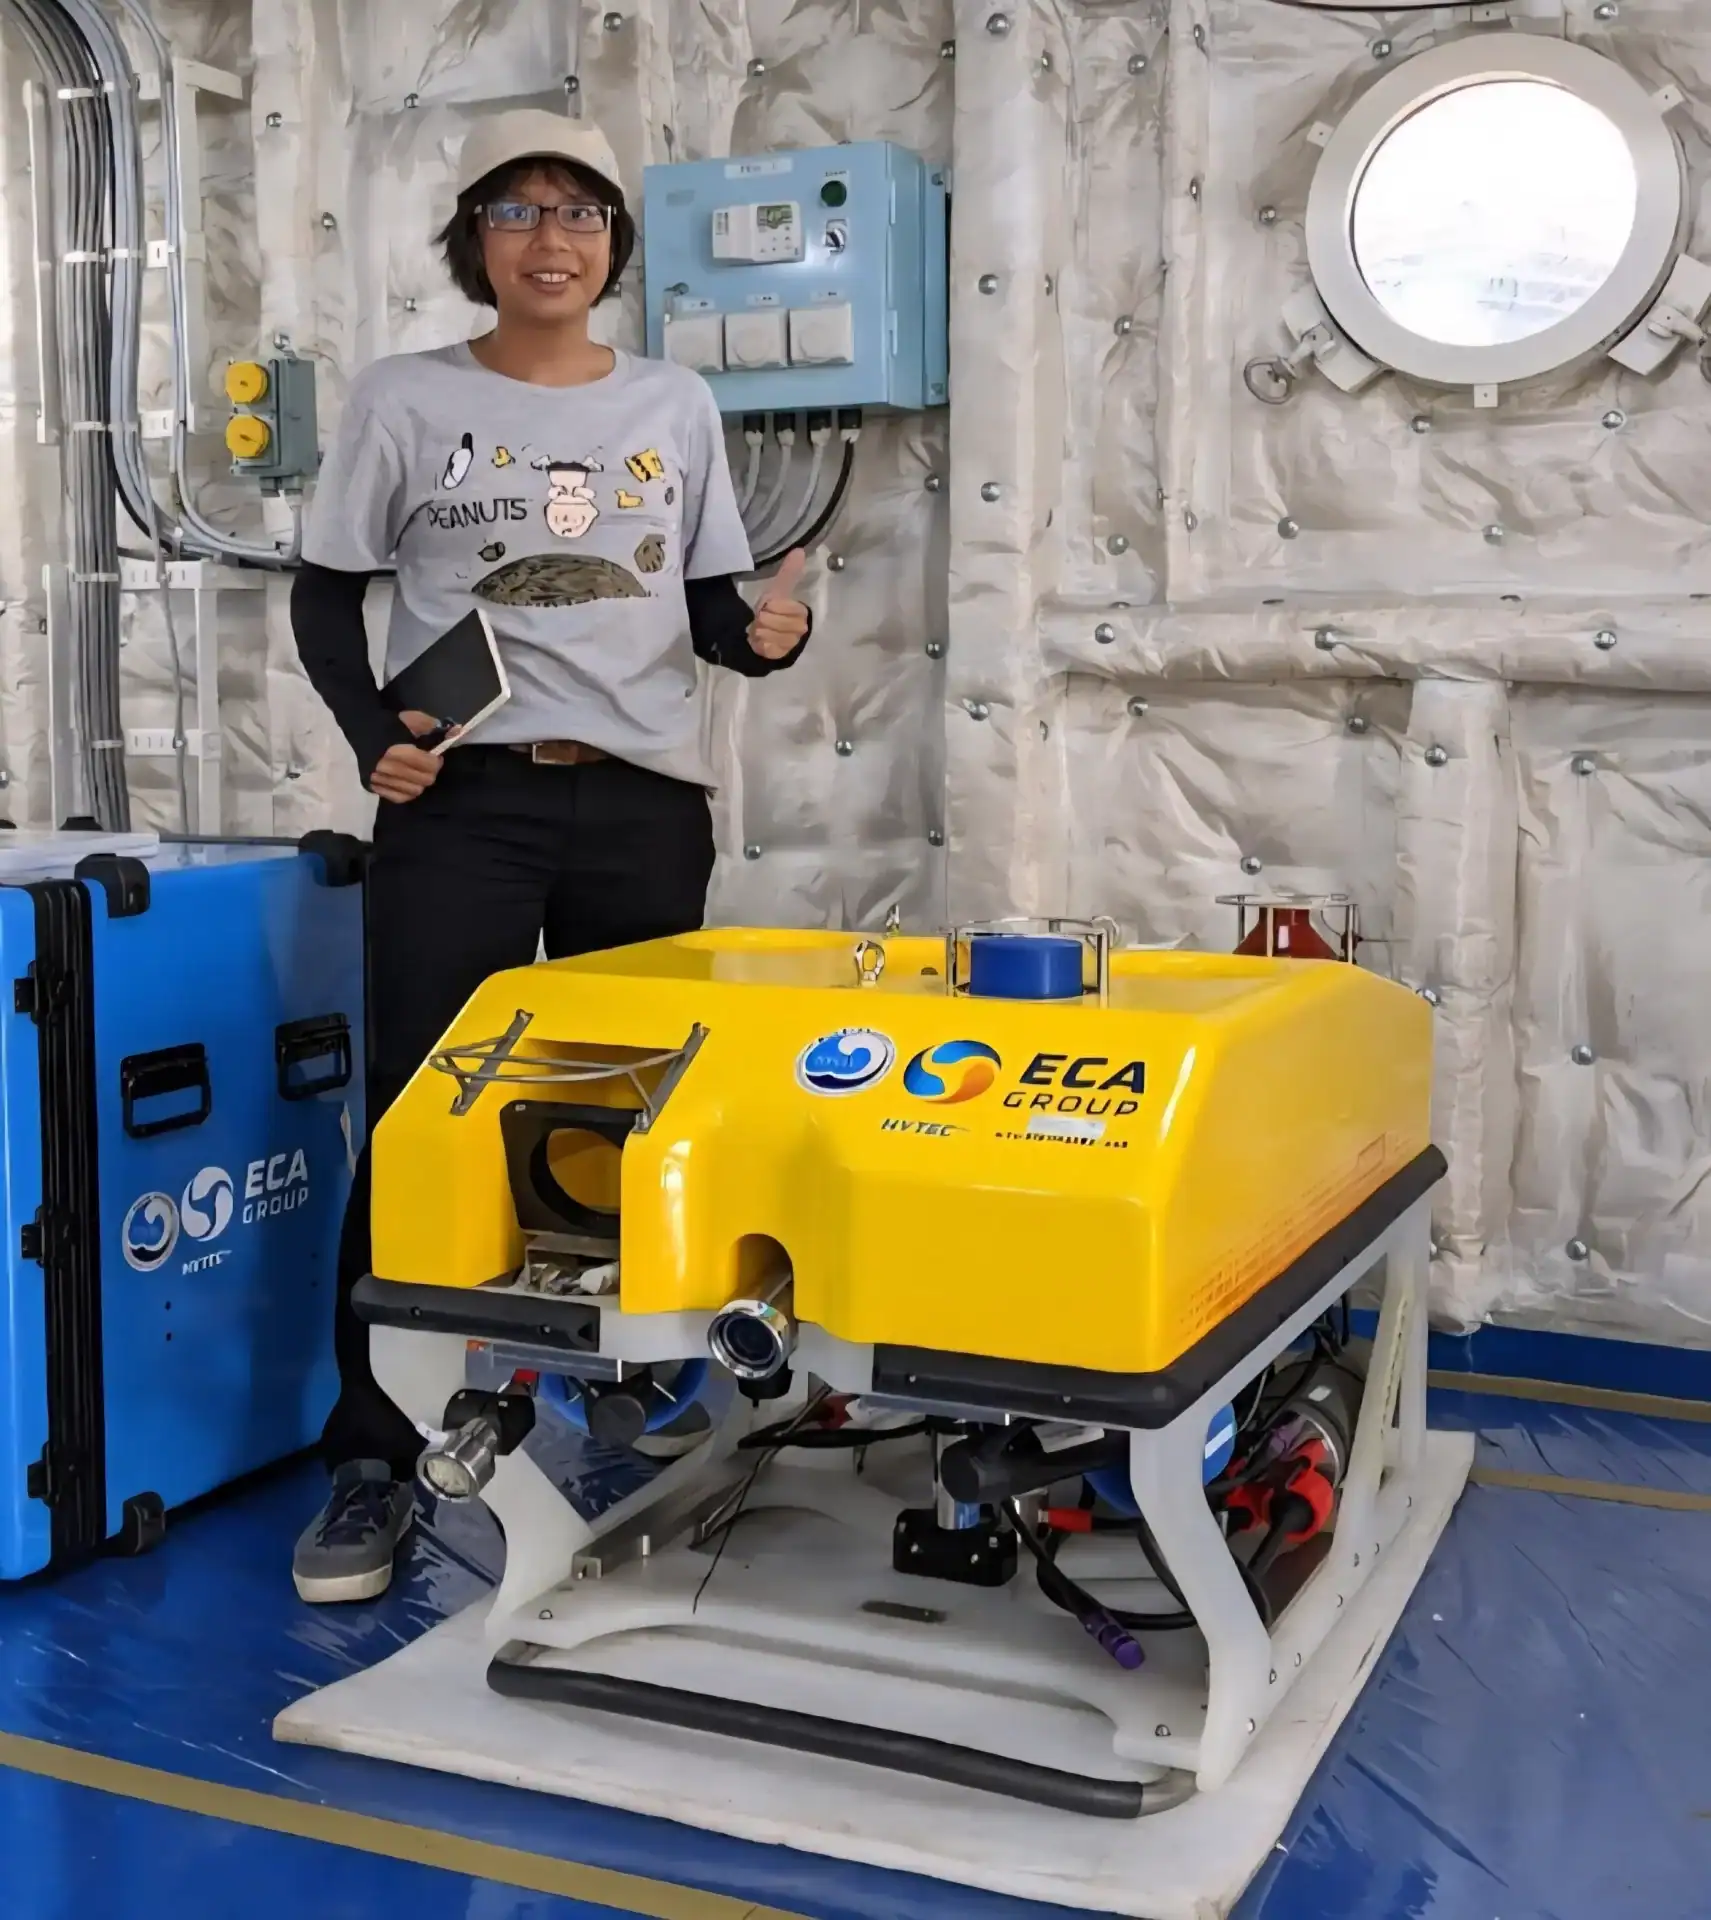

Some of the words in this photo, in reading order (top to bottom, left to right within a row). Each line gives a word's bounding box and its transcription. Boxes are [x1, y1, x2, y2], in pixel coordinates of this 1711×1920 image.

[427, 498, 528, 530] PEANUTS
[1019, 1053, 1145, 1094] ECA
[1003, 1091, 1139, 1117] GROUP
[244, 1148, 309, 1199] ECA
[242, 1187, 309, 1224] GROUP
